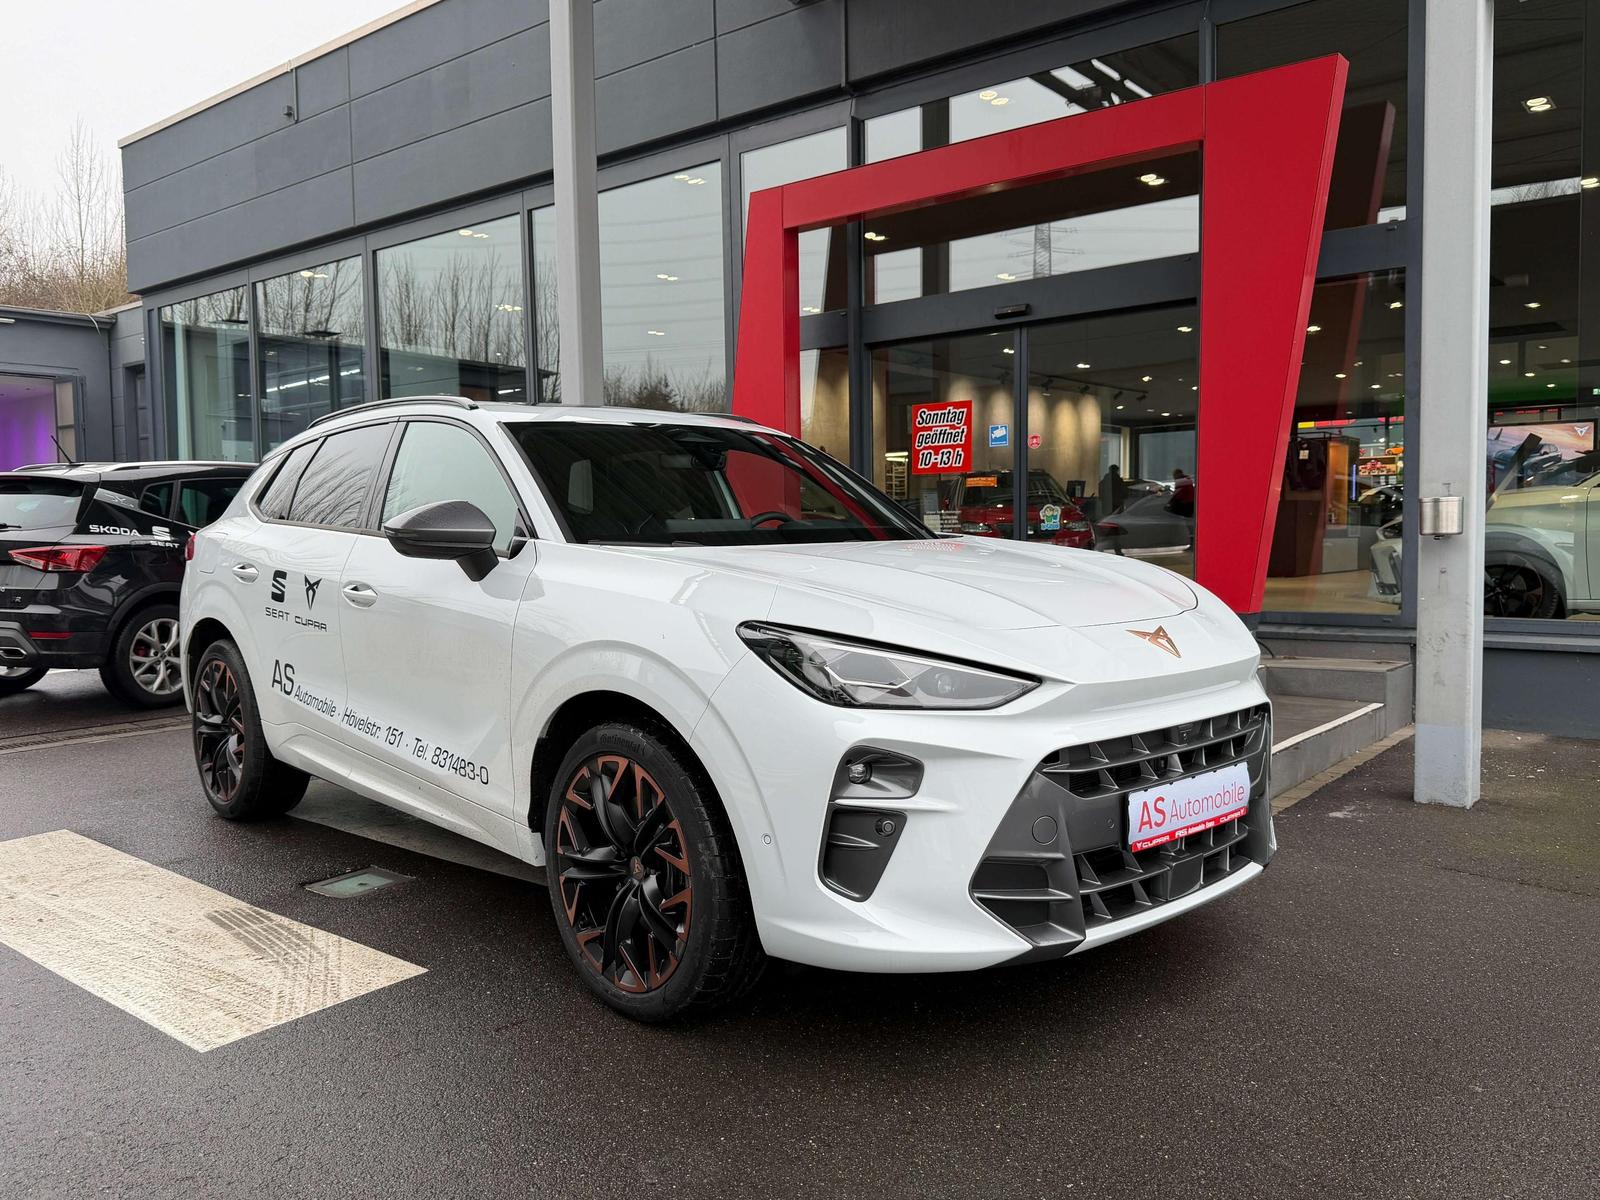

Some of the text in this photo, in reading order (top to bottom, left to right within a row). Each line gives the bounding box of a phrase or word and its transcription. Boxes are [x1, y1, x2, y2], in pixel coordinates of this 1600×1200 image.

[917, 407, 966, 426] Sonntag
[916, 428, 966, 447] geöffnet
[954, 449, 963, 466] h
[150, 540, 180, 548] SEAT
[265, 607, 327, 632] SEAT CUPRA
[271, 659, 489, 785] AS Automobile Hövelstr. 151 Tel. 831483-0
[1138, 781, 1245, 833] AS Automobile
